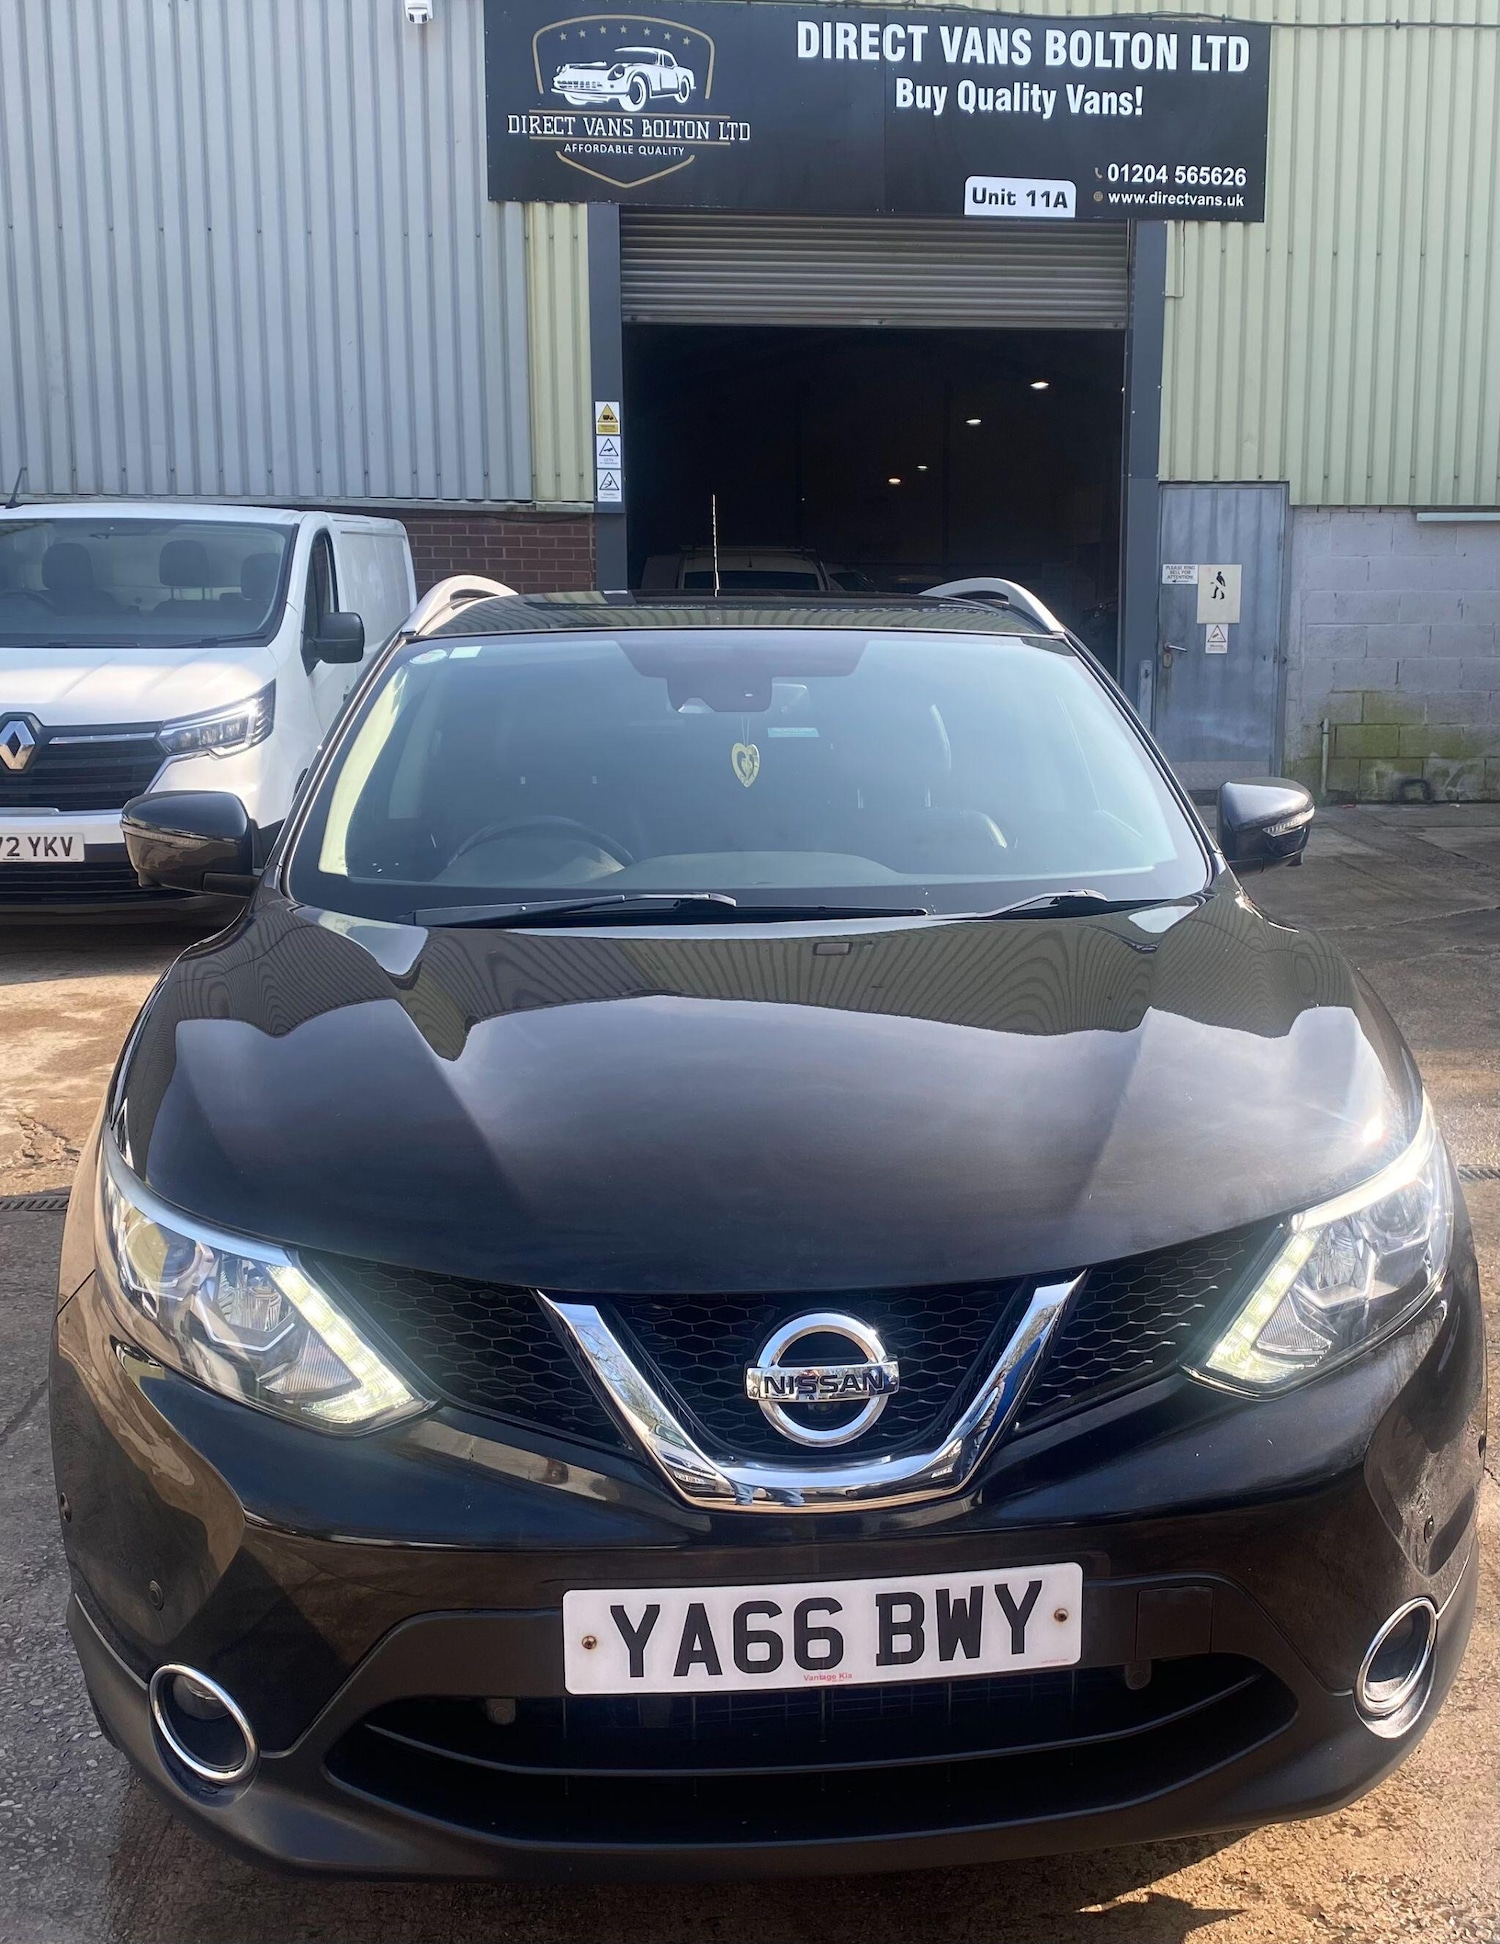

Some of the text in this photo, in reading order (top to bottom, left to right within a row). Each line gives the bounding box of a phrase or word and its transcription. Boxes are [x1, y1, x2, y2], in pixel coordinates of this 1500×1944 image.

[796, 21, 1250, 72] DIRECT VANS BOLTON LTD
[895, 78, 1144, 119] Buy Quality Vans!
[507, 115, 751, 141] DIRECT VANS BOLTON LTD
[564, 143, 685, 156] AFFORDABLE QUALITY
[1107, 163, 1247, 187] 01204 565626
[971, 187, 1068, 209] Unit 11A
[1108, 189, 1245, 207] www.directvans.uk
[27, 836, 73, 857] YKV
[764, 1368, 883, 1394] NISSAN
[610, 1580, 1043, 1677] YA66 BWY
[803, 1674, 837, 1682] Vantage
